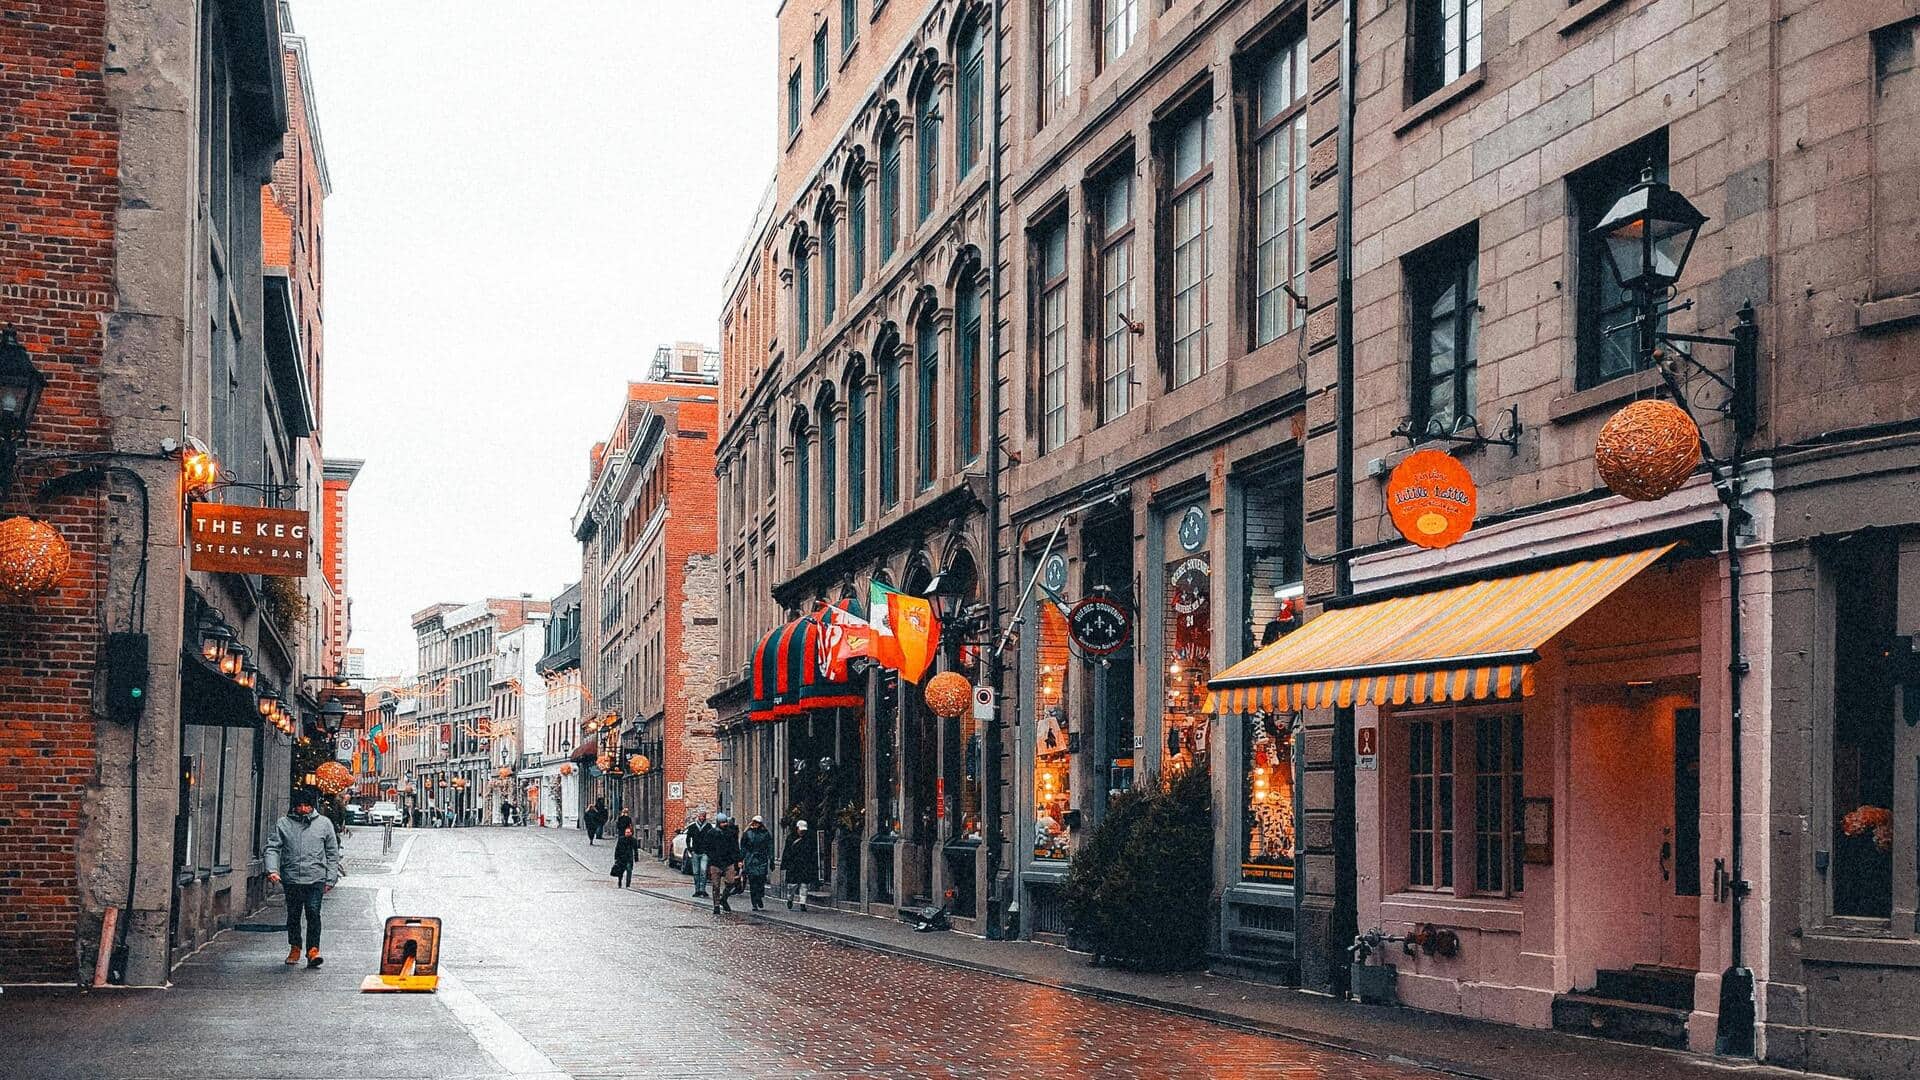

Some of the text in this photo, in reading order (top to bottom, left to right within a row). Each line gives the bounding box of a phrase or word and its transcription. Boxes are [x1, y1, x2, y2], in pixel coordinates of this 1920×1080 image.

[196, 518, 305, 539] THE KEG
[195, 543, 251, 556] STEAK
[271, 549, 303, 559] BAR
